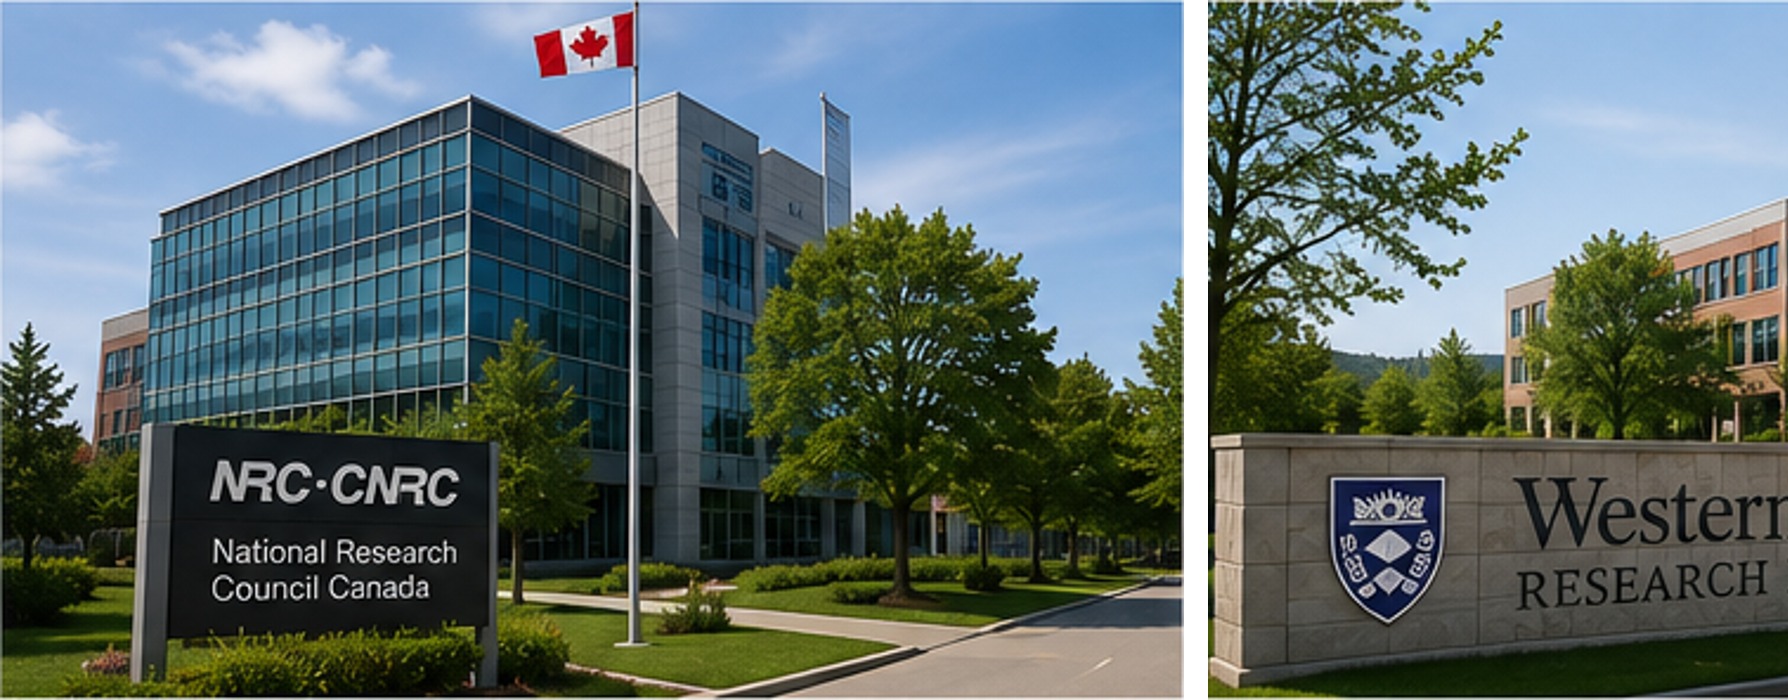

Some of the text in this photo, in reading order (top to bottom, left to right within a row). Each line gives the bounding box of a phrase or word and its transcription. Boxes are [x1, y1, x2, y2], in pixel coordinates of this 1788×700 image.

[212, 538, 457, 564] National Research
[212, 574, 430, 601] Council Canada
[1515, 560, 1768, 610] RESEARCH
